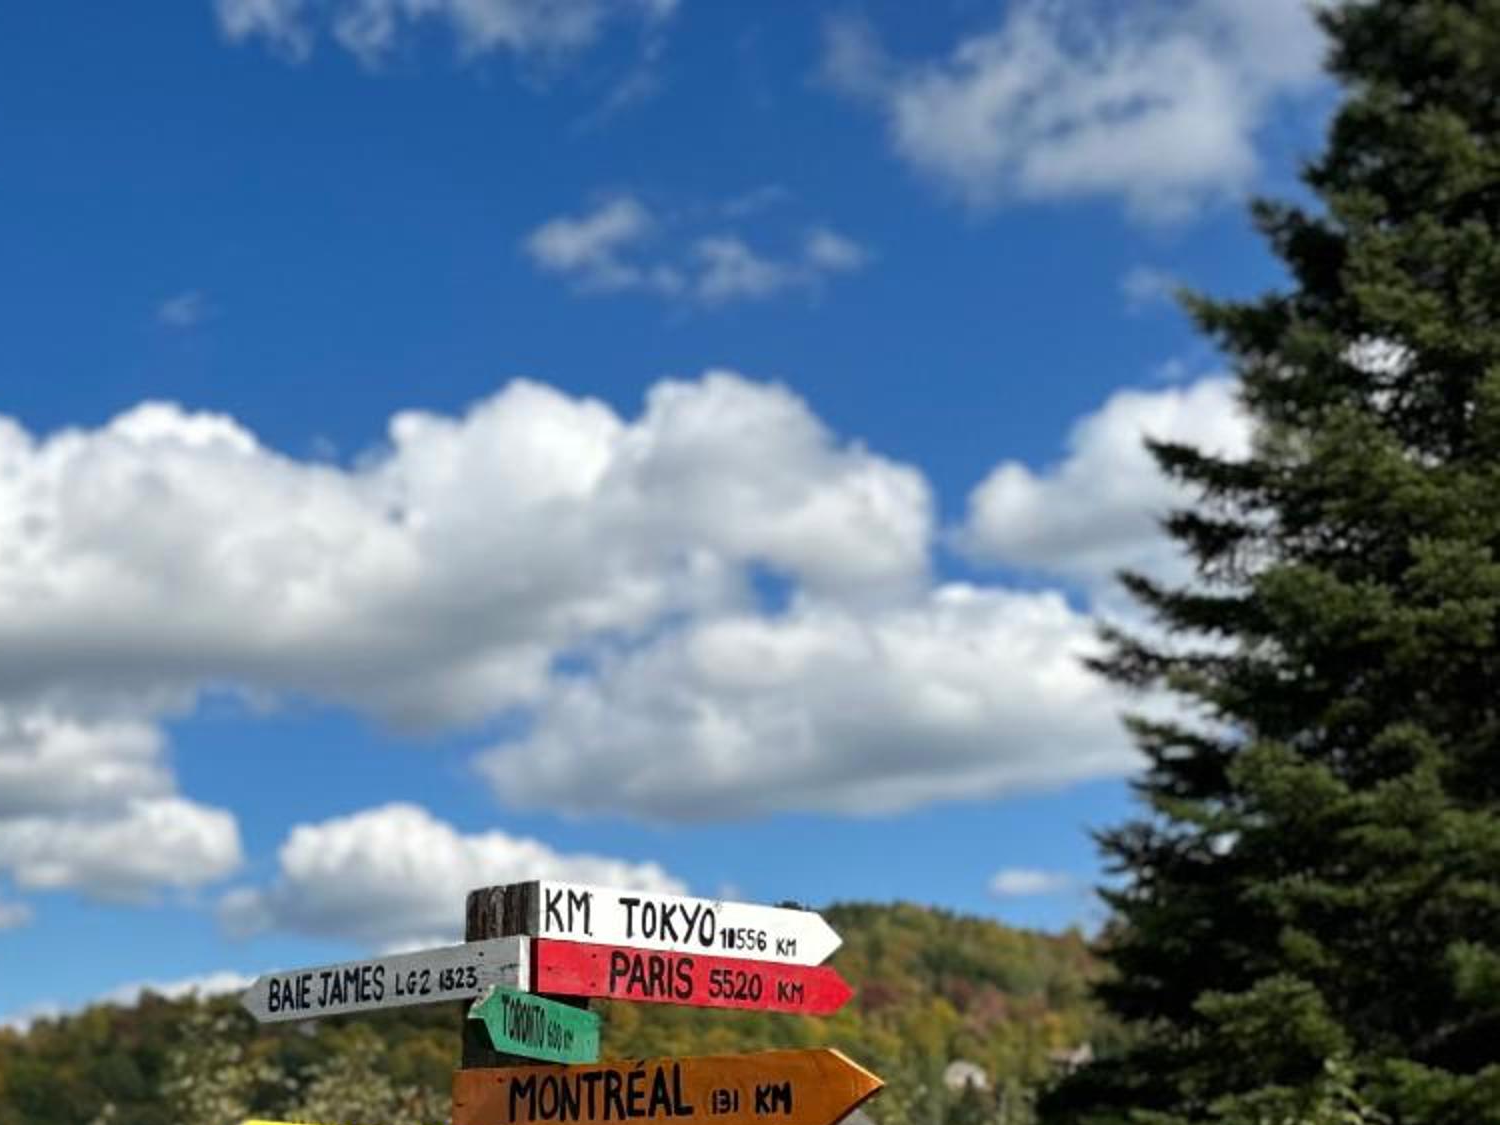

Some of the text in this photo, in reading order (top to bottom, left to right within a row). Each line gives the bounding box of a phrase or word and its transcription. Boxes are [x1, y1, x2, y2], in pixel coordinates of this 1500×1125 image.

[546, 888, 590, 934] KM
[619, 897, 716, 947] TOKYO
[776, 937, 797, 957] KM
[269, 974, 312, 1012] BAIE
[317, 965, 385, 1008] JAMES
[395, 969, 431, 996] LG2
[609, 951, 805, 1003] PARIS 5520 KM
[509, 1060, 694, 1123] MONTRÉAL
[755, 1082, 792, 1114] KM
